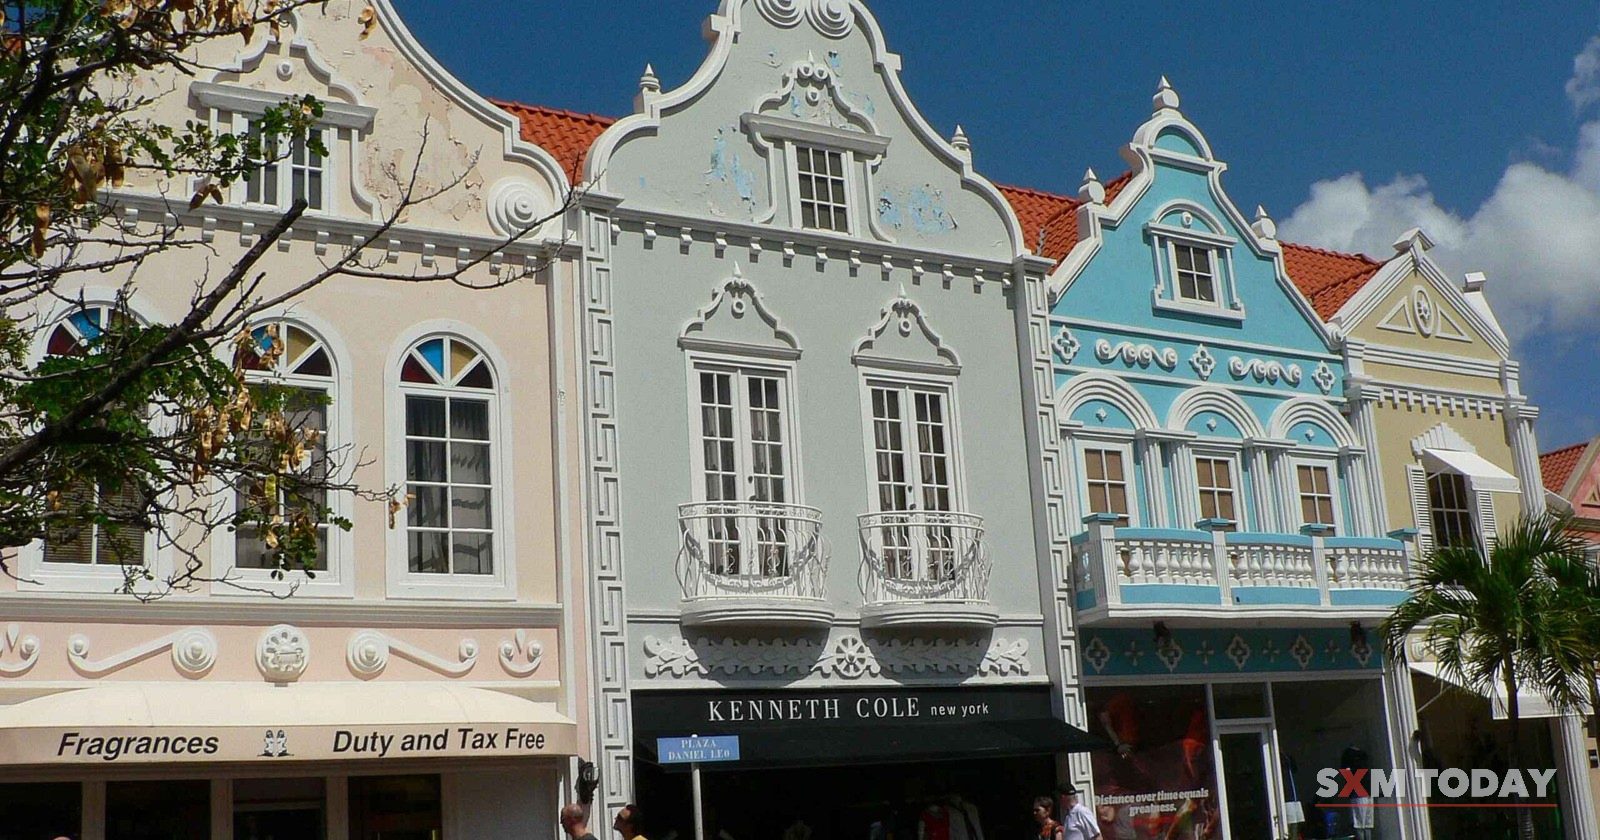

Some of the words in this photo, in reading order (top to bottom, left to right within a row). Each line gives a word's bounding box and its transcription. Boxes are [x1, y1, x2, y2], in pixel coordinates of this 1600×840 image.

[708, 699, 840, 721] KENNETH
[856, 697, 920, 718] COLE
[930, 704, 956, 716] new
[961, 703, 989, 717] york
[57, 732, 219, 761] Fragrances
[333, 730, 393, 757] Duty
[400, 728, 449, 750] and
[458, 728, 498, 749] Tax
[505, 728, 545, 749] Free
[681, 738, 716, 748] PLAZA
[668, 750, 706, 760] DANIEL
[1094, 794, 1134, 806] Distance
[1135, 793, 1156, 803] over
[1156, 790, 1178, 801] time
[1178, 788, 1209, 801] equals
[1128, 802, 1177, 817] greatness.
